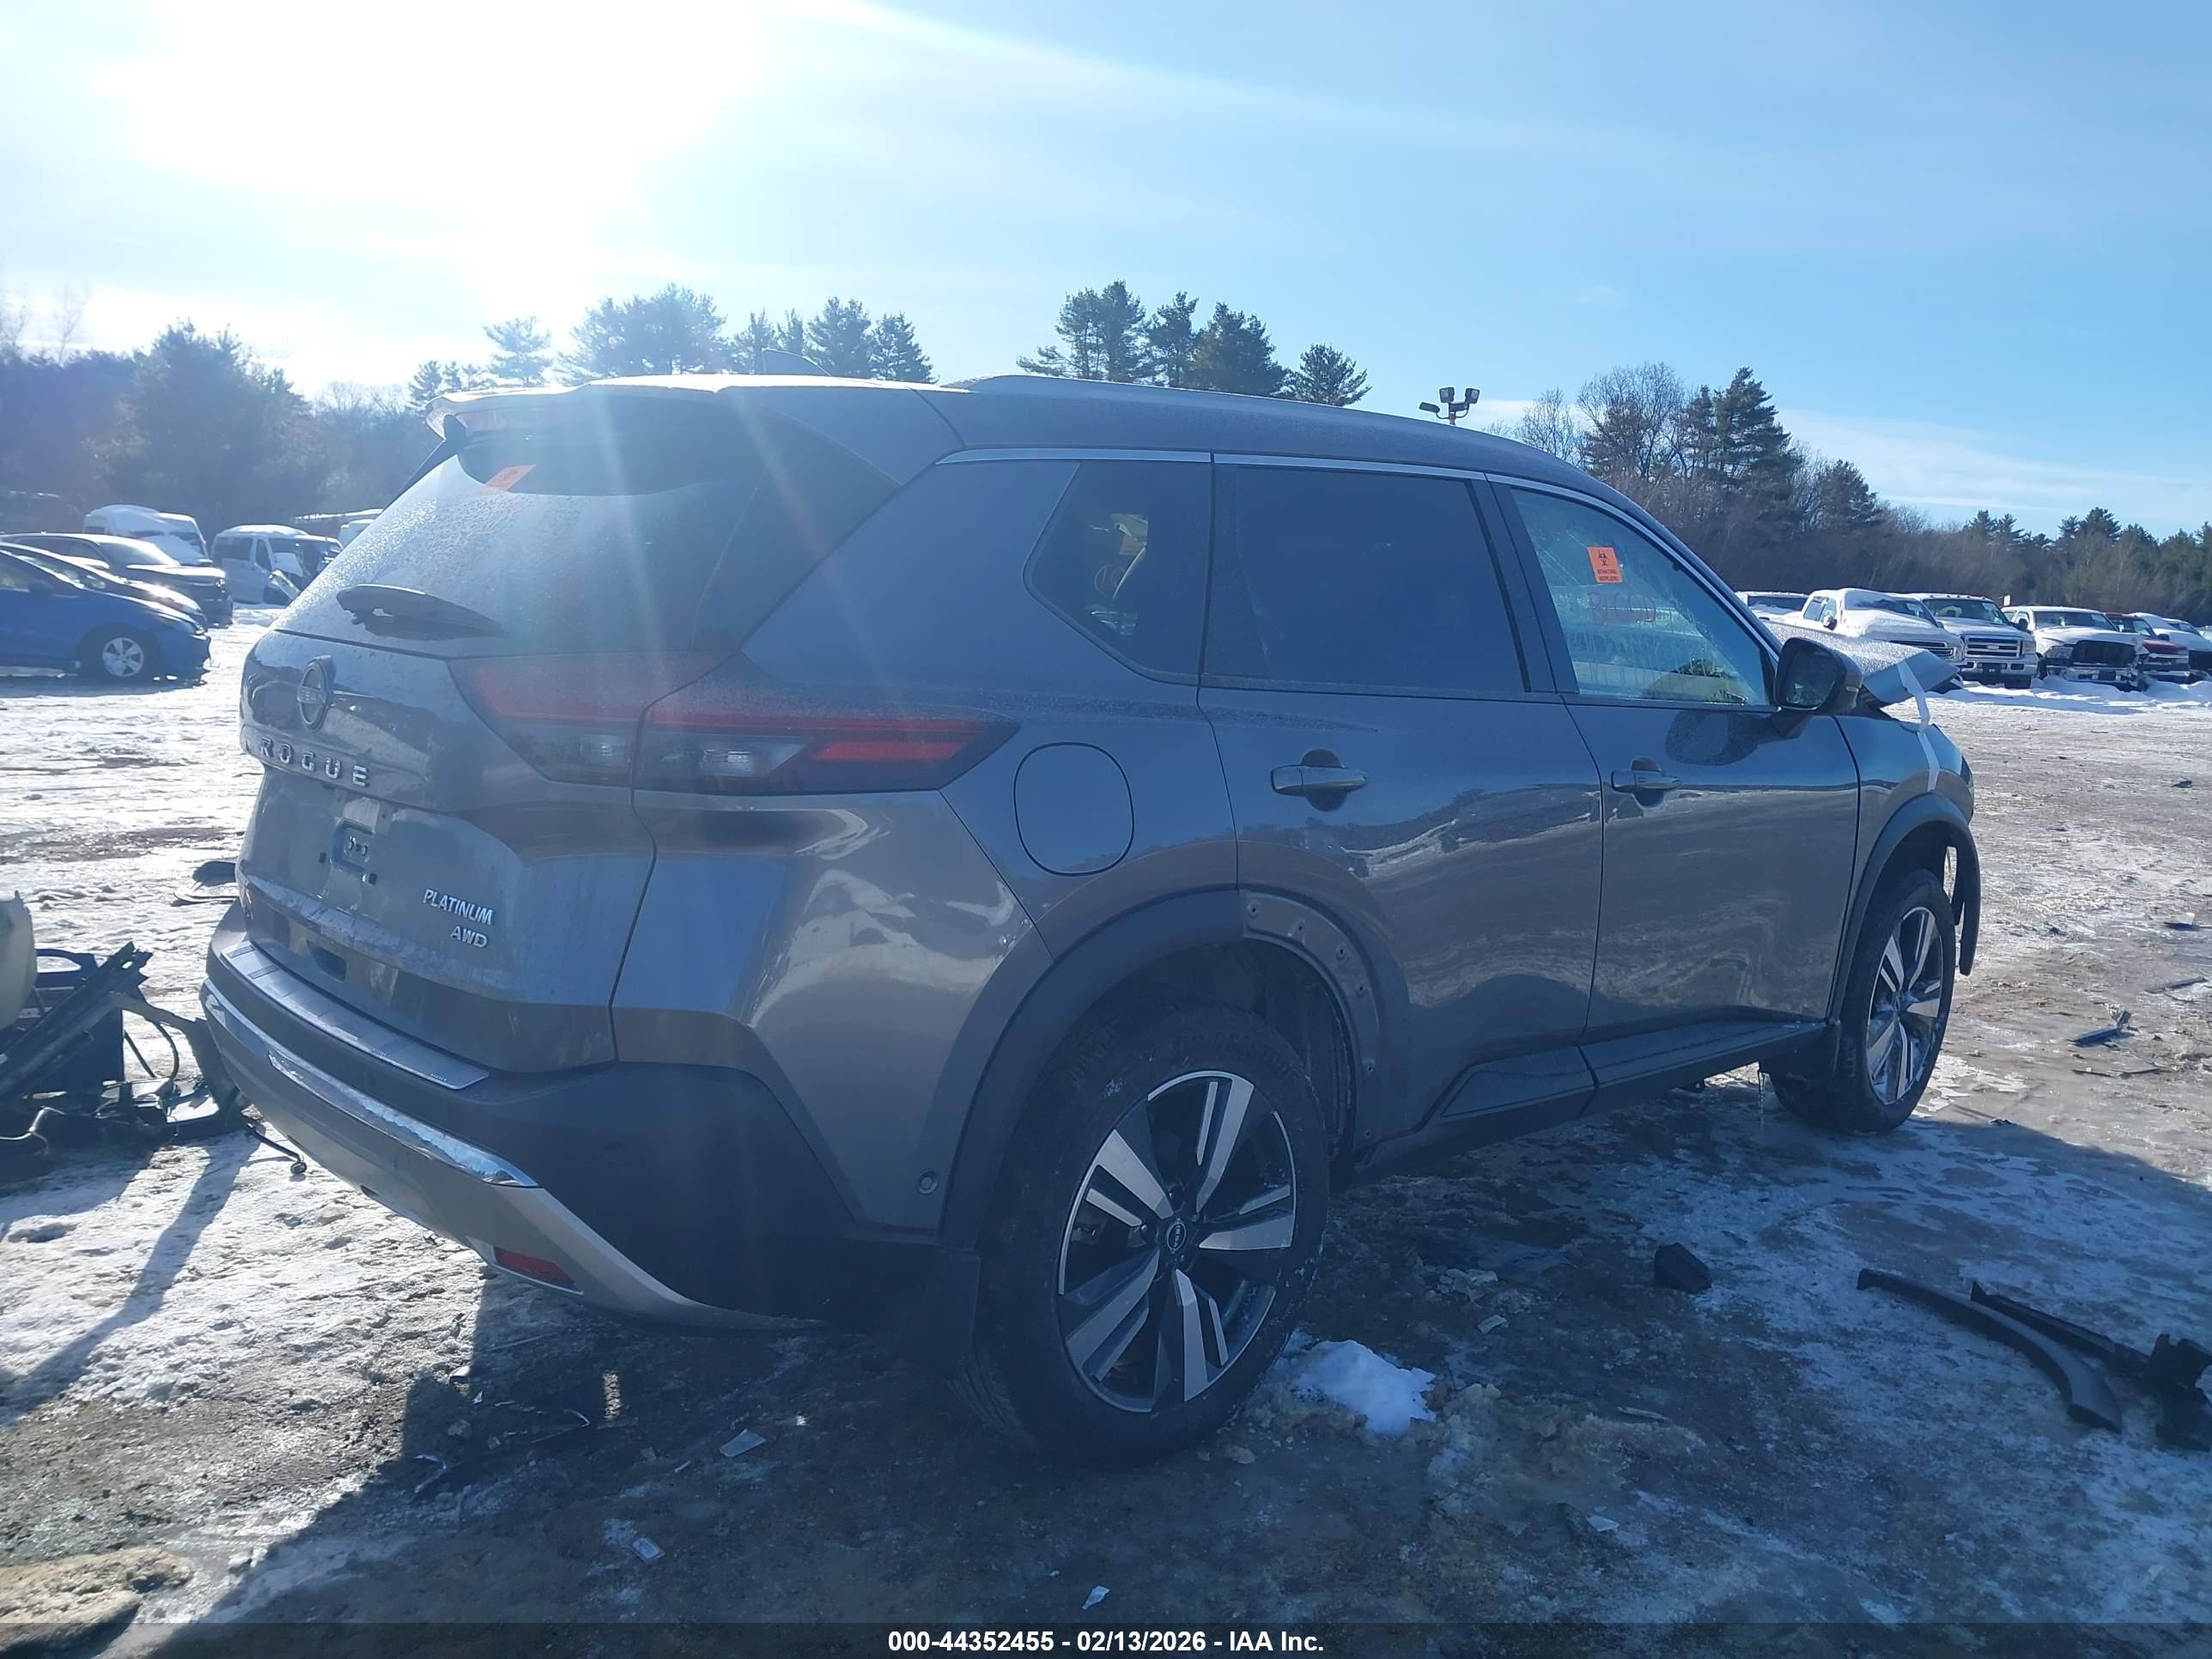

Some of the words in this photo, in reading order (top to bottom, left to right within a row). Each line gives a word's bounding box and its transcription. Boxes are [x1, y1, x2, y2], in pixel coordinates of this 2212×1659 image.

[260, 737, 369, 787] ROGUE
[422, 888, 495, 926] PLATINUM
[449, 926, 488, 948] AWD
